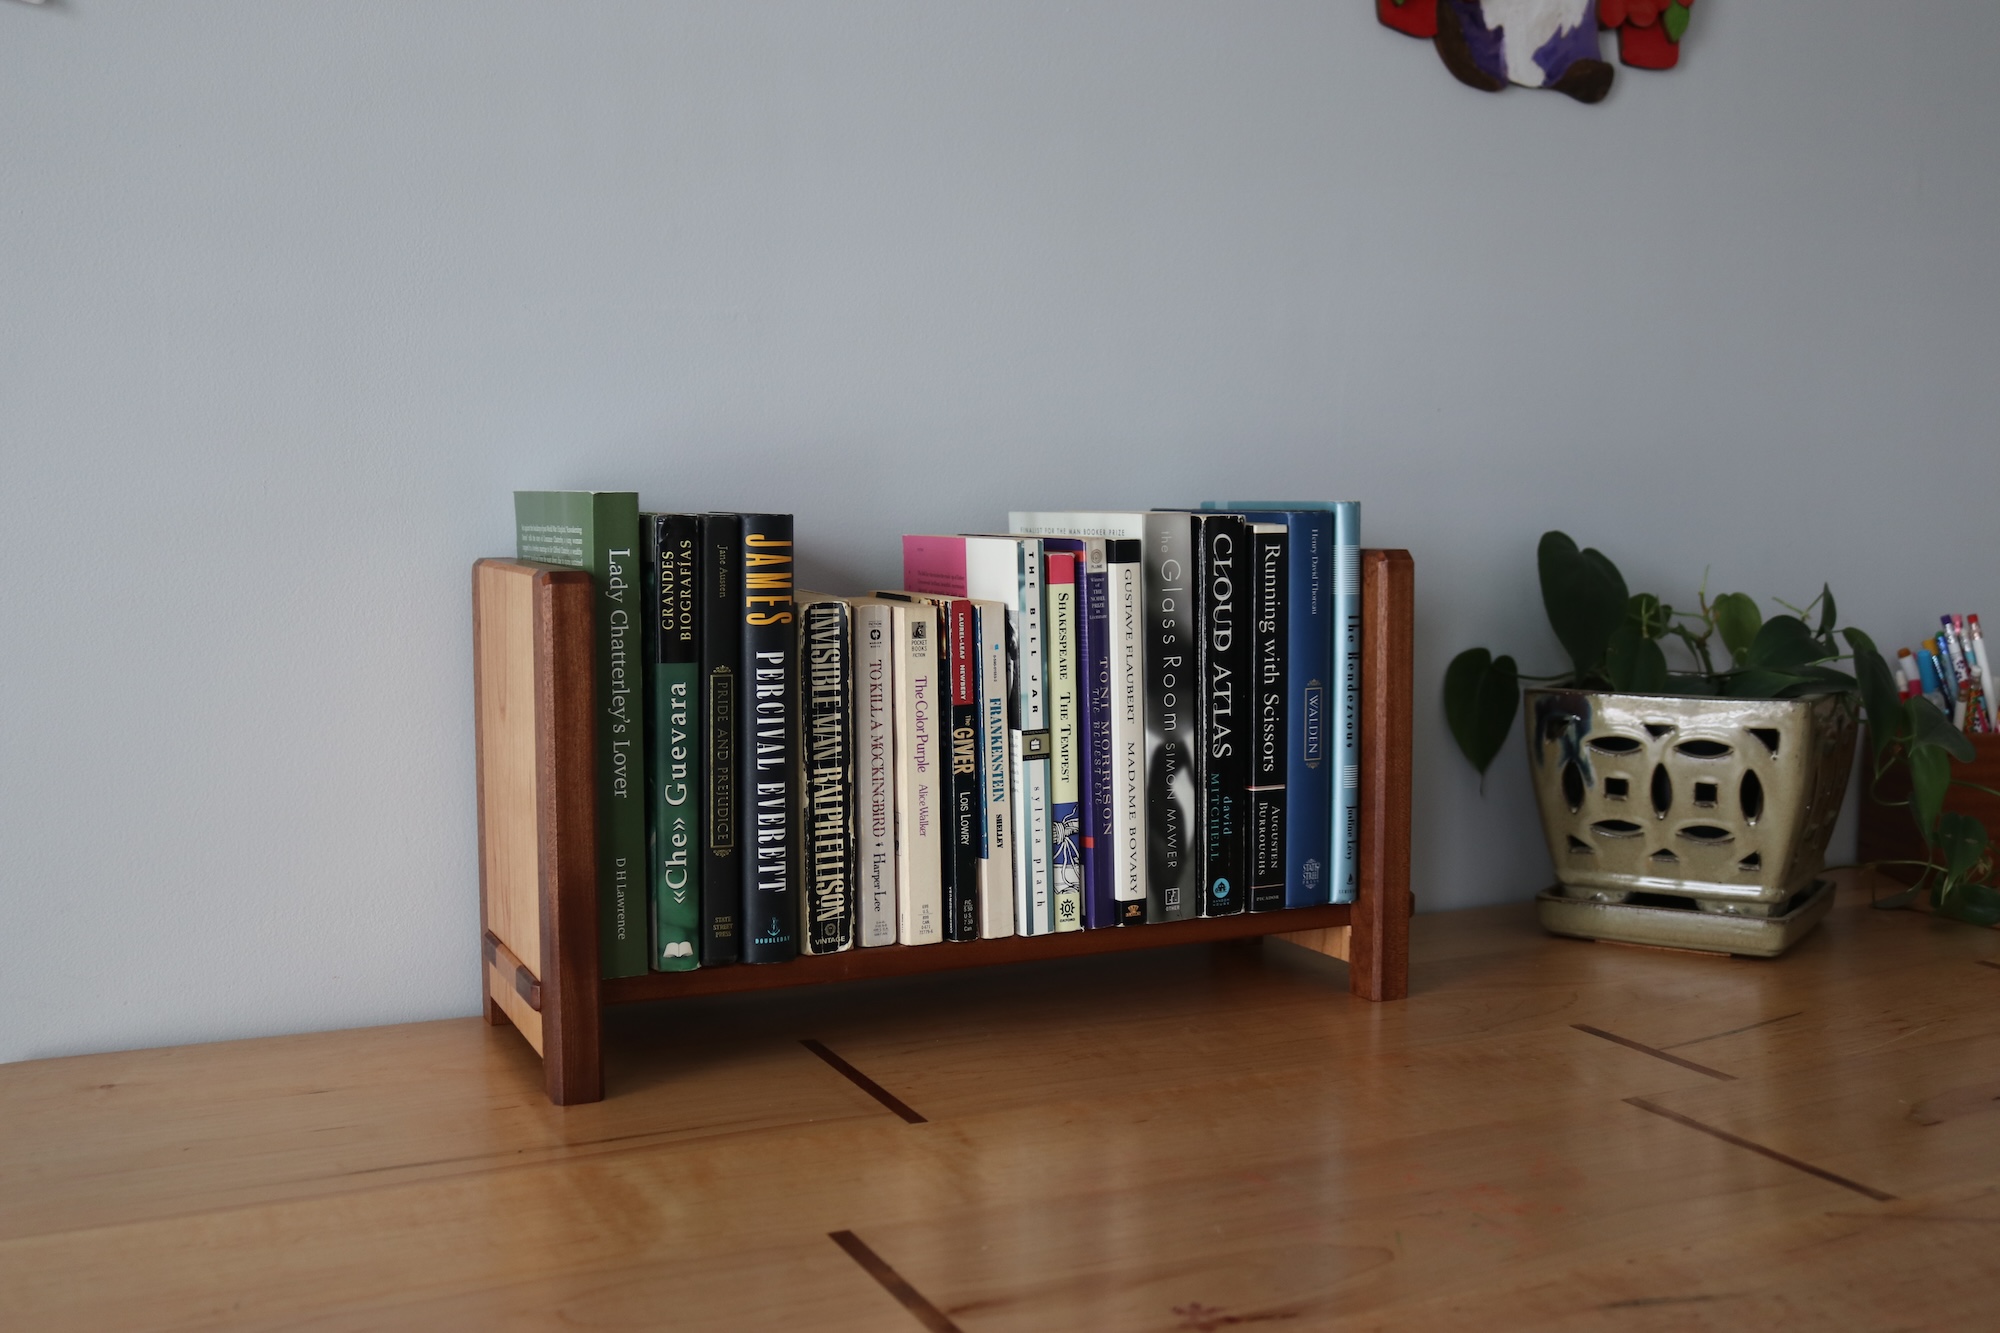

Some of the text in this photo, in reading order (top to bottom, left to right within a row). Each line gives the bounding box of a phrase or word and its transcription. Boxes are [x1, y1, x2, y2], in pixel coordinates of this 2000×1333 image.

[717, 545, 728, 598] Jane Austen
[1028, 552, 1036, 589] THE
[1108, 529, 1125, 537] PRIZE
[1308, 529, 1318, 554] Henry
[662, 551, 674, 630] GRANDES
[677, 540, 692, 640] BIOGRAFÍAS
[745, 534, 793, 626] JAMES
[605, 548, 631, 799] Lady Chatterley's Lover
[869, 659, 883, 681] TO
[958, 612, 967, 701] LAUREL-LEAF NEWBERY
[1212, 533, 1233, 759] CLOUD ATLAS
[1258, 544, 1281, 772] Running with Scissors
[1346, 615, 1359, 748] The Rendezvous
[870, 682, 883, 714] KILL
[871, 716, 883, 731] A
[964, 714, 972, 726] The
[1031, 675, 1039, 713] JAR
[1058, 592, 1072, 783] SHAKESPEARE THE TEMPEST
[1161, 531, 1183, 868] the Glass Room SIMON MAWER
[1308, 694, 1319, 754] WALDEN
[717, 682, 729, 840] PRIDE AND PREJUDICE
[810, 605, 845, 922] INVISIBLE MAN RALPH ELLISON
[914, 676, 930, 837] The Color Purple Alice Walker
[953, 727, 976, 775] GIVER
[1092, 688, 1103, 805] THE BLUEST EYE
[1099, 656, 1113, 836] TONI MORRISON
[1124, 569, 1138, 894] GUSTAVE FLAUBERT MADAME BOVARY
[664, 682, 688, 904] «Che» Guevara
[756, 651, 787, 893] PERCIVAL EVERETT
[871, 735, 886, 838] MOCKINGBIRD
[990, 698, 1004, 849] FRANKENSTEIN SHELLEY
[960, 791, 972, 846] LOIS LOWRY
[1031, 786, 1045, 907] sylvia plath
[1211, 773, 1220, 862] MITCHELL
[1223, 796, 1233, 835] david
[1258, 802, 1269, 876] BURROUGHS
[1270, 806, 1281, 869] AUGUSTEN
[1346, 806, 1357, 838] Justine
[616, 857, 627, 940] D H Lawrence
[872, 853, 886, 890] Harper
[873, 890, 887, 912] Lee
[1256, 894, 1280, 902] PICADOR
[713, 923, 734, 931] STREET
[755, 935, 790, 944] DOUBLEDAY
[814, 936, 846, 946] VINTAGE
